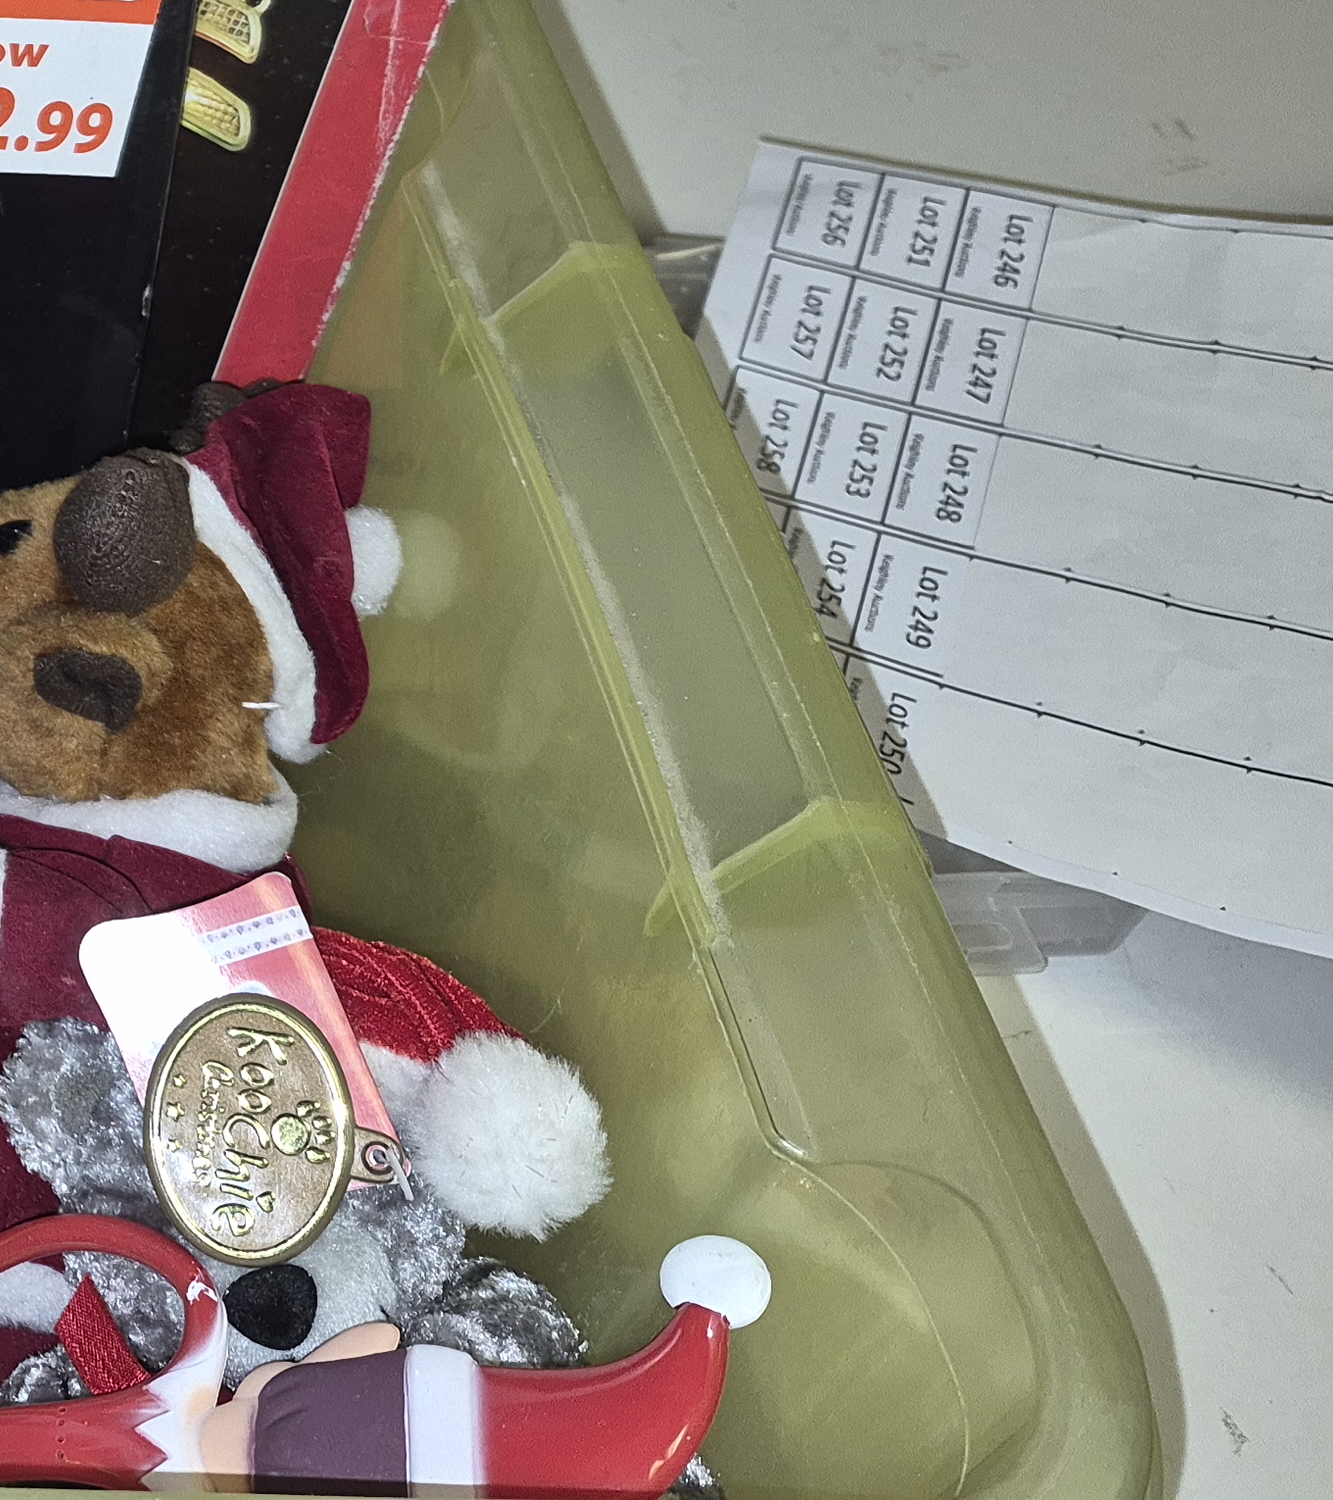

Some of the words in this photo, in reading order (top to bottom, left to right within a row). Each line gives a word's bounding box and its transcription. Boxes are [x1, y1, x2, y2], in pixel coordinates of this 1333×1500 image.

[834, 180, 862, 208] Lot
[917, 196, 947, 225] Lot
[907, 227, 937, 267] 251
[1003, 213, 1033, 245] Lot
[992, 249, 1025, 290] 246
[801, 285, 831, 316] Lot
[791, 319, 821, 360] 257
[888, 306, 918, 340] Lot
[875, 342, 908, 381] 252
[973, 327, 1007, 360] Lot
[966, 362, 997, 404] 247
[769, 399, 799, 430] Lot
[856, 421, 888, 455] Lot
[845, 458, 877, 499] 253
[945, 444, 978, 480] Lot
[935, 482, 968, 523] 248
[825, 540, 856, 574] Lot
[916, 566, 948, 602] Lot
[905, 606, 939, 649] 249
[885, 692, 917, 729] Lot
